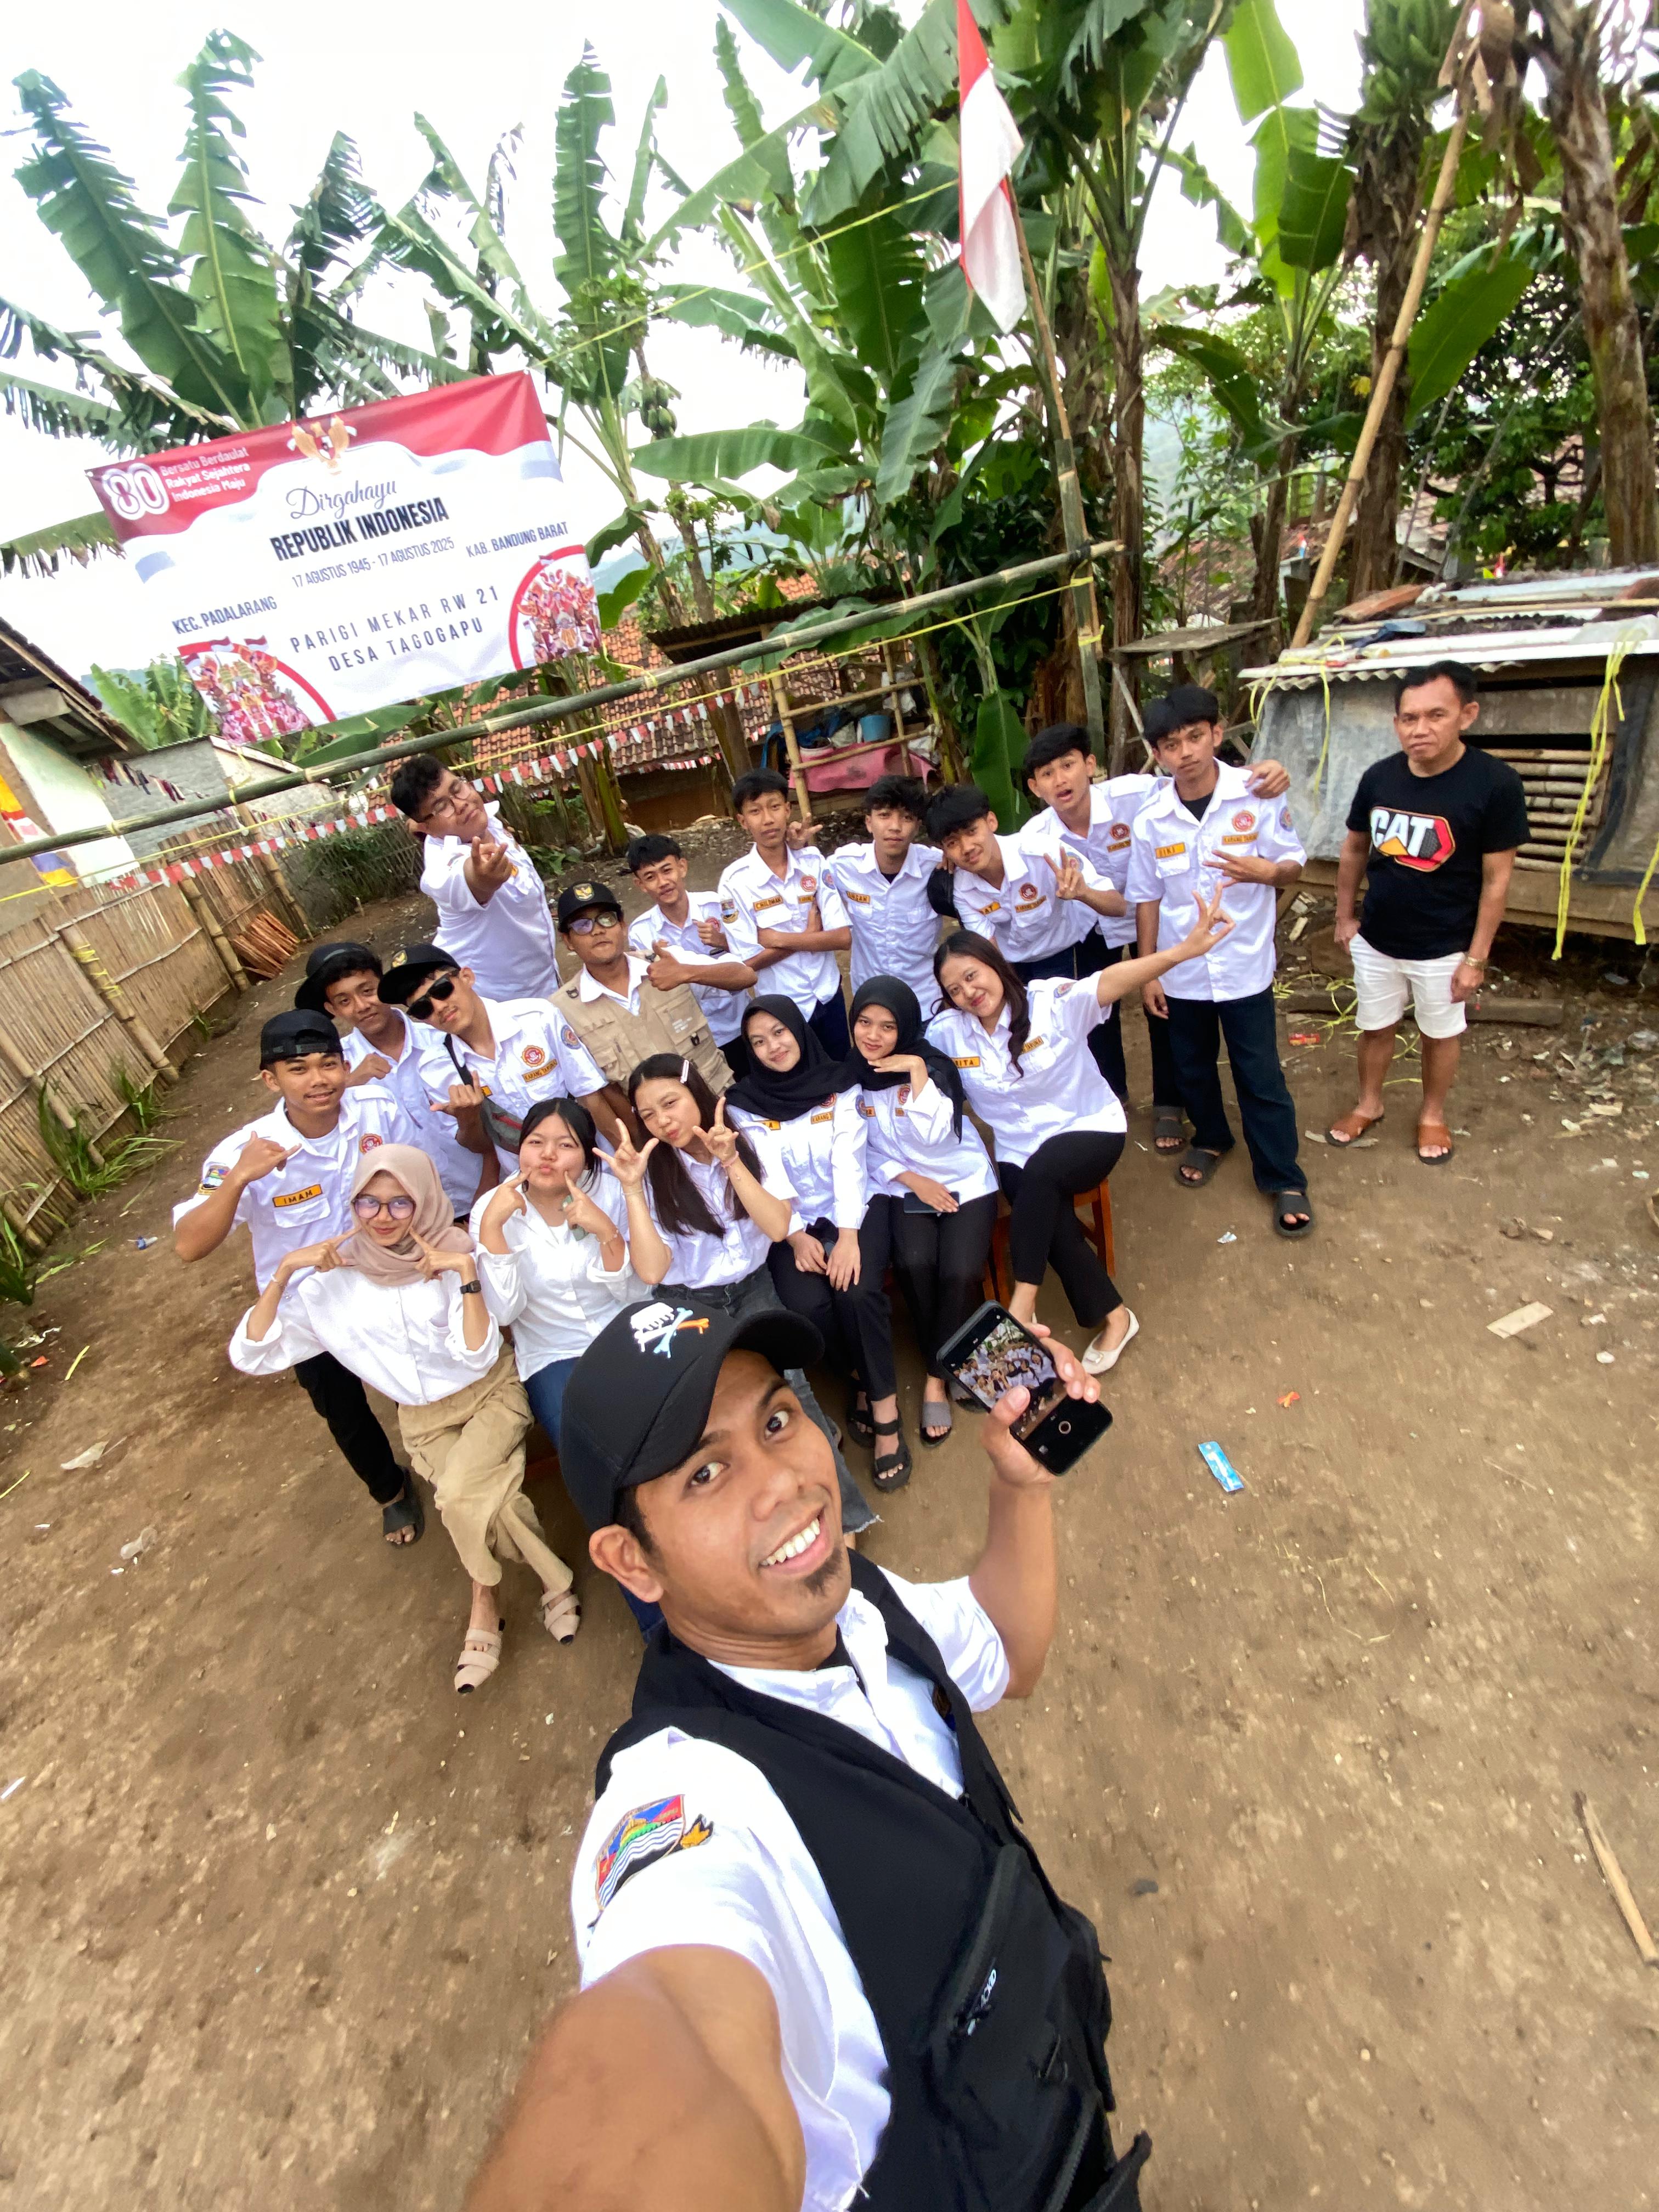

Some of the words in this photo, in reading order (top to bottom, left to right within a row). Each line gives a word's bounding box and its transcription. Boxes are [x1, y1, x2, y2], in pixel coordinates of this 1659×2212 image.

[160, 458, 200, 477] Bersatu
[199, 447, 249, 467] Berdaulat
[165, 472, 202, 489] Rakyat
[203, 462, 251, 481] Sejahtera
[102, 462, 170, 520] 80
[171, 482, 221, 502] Indonesia
[220, 478, 246, 493] Maju
[285, 479, 397, 520] Dirgahayu
[269, 519, 359, 561] REPUBLIK
[355, 496, 450, 540] INDONESIA
[466, 541, 491, 558] KAB.
[491, 529, 538, 552] BANDUNG
[537, 521, 569, 540] BARAT
[292, 574, 303, 588] 17
[305, 564, 347, 585] AGUSTUS
[347, 557, 371, 574] 1945
[377, 553, 389, 567] 17
[390, 543, 431, 563] AGUSTUS
[431, 536, 455, 554] 2025
[171, 616, 203, 635] KEC.
[200, 595, 278, 627] PADALARANG
[290, 622, 358, 653] PARIGI
[366, 603, 432, 633] MEKAR
[439, 593, 466, 614] RW
[476, 585, 499, 605] 21
[328, 646, 380, 672] DESA
[386, 617, 483, 656] TAGOGAPU
[1370, 808, 1435, 857] CAT
[283, 1189, 313, 1204] IMAM
